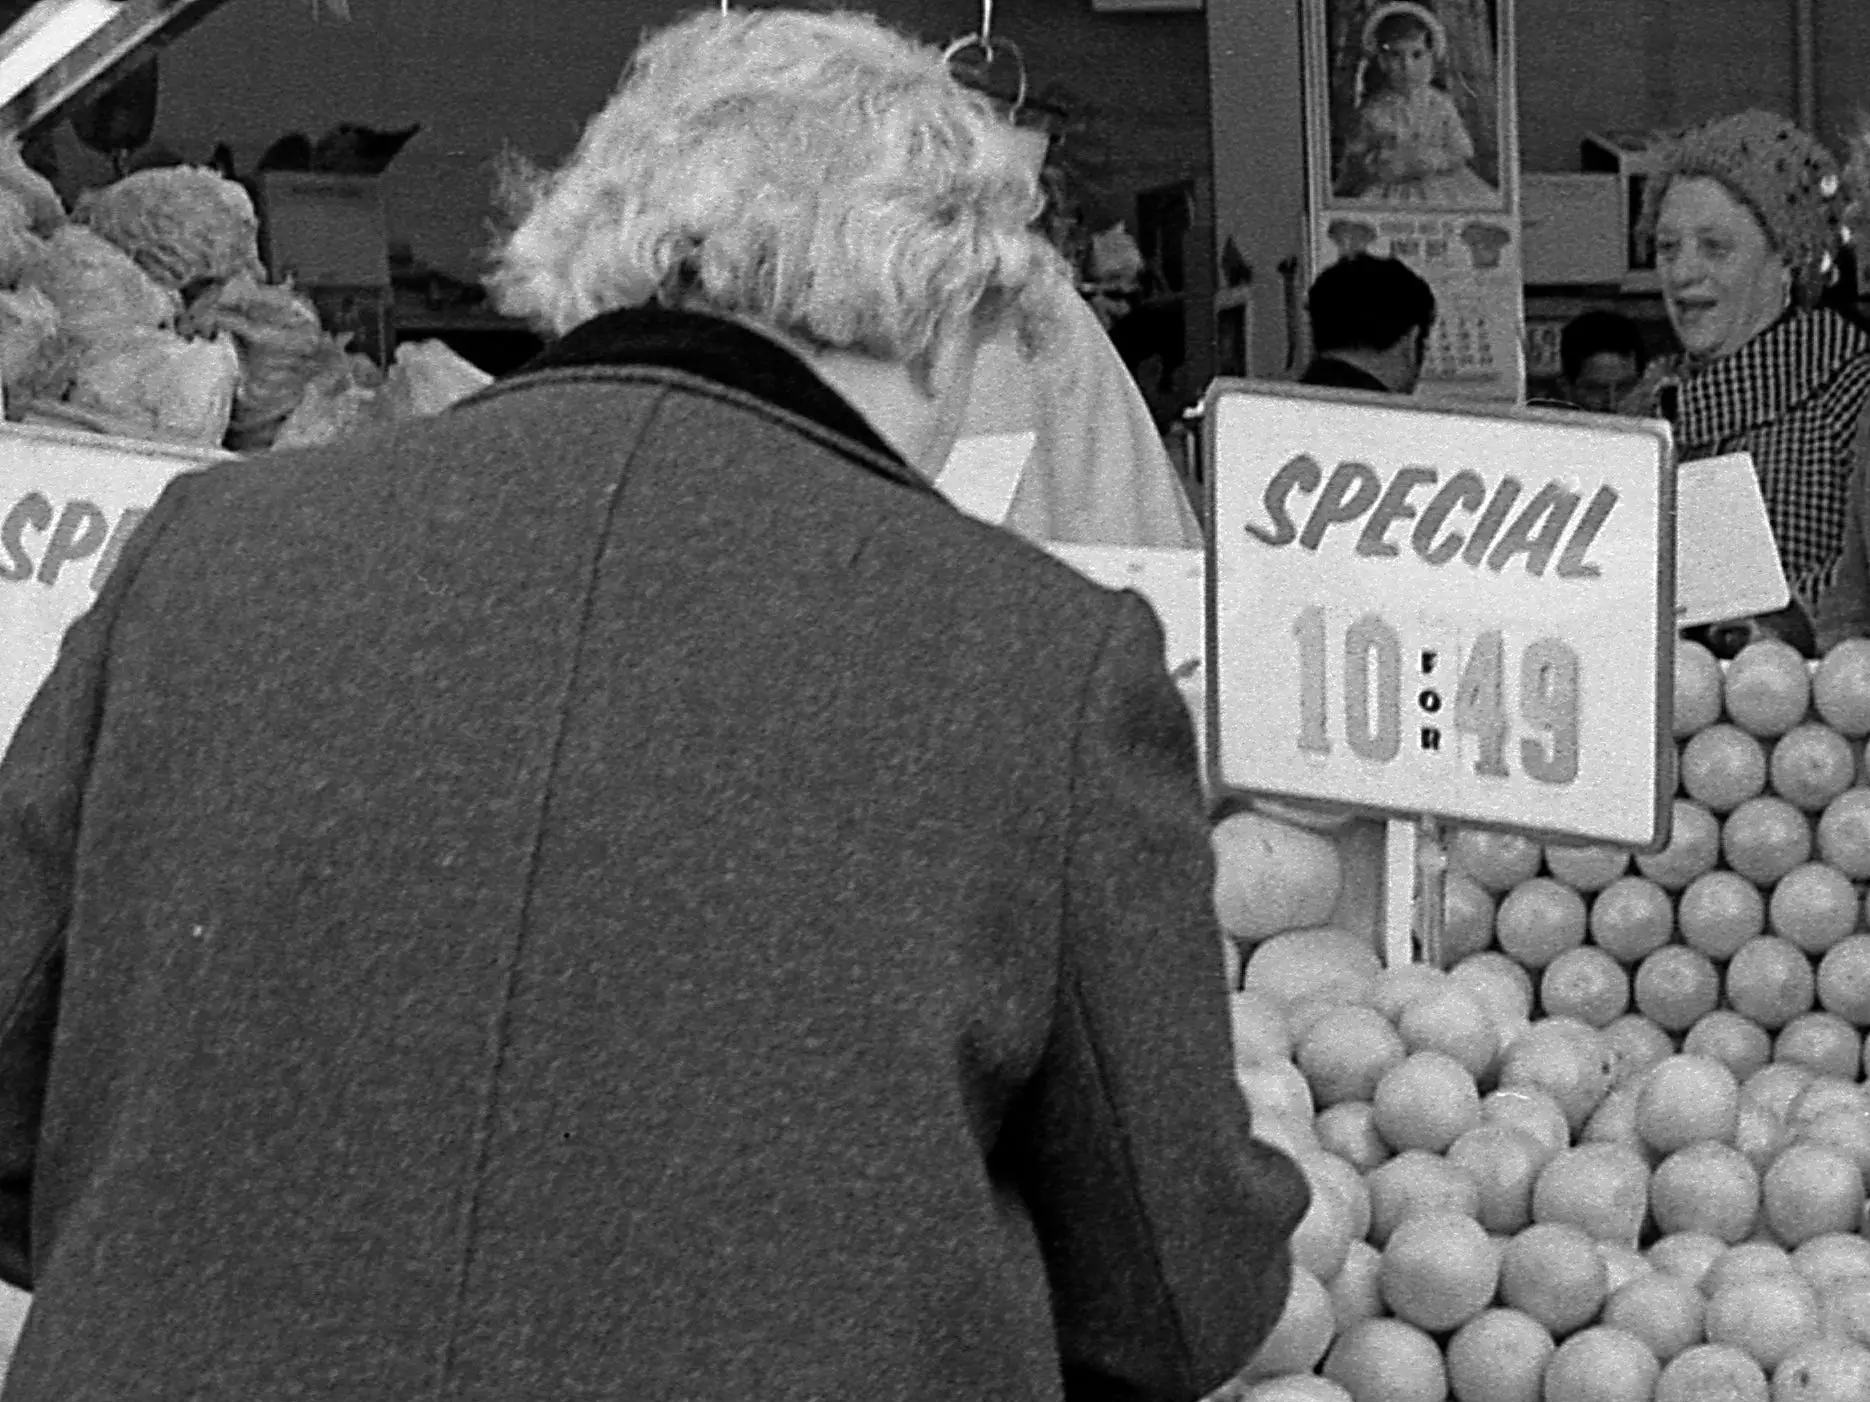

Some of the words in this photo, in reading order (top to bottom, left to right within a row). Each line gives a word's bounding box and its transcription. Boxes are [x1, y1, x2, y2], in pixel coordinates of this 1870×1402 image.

[1244, 453, 1619, 579] SPECIAL
[1293, 605, 1403, 763] 10
[1454, 629, 1580, 786] 49
